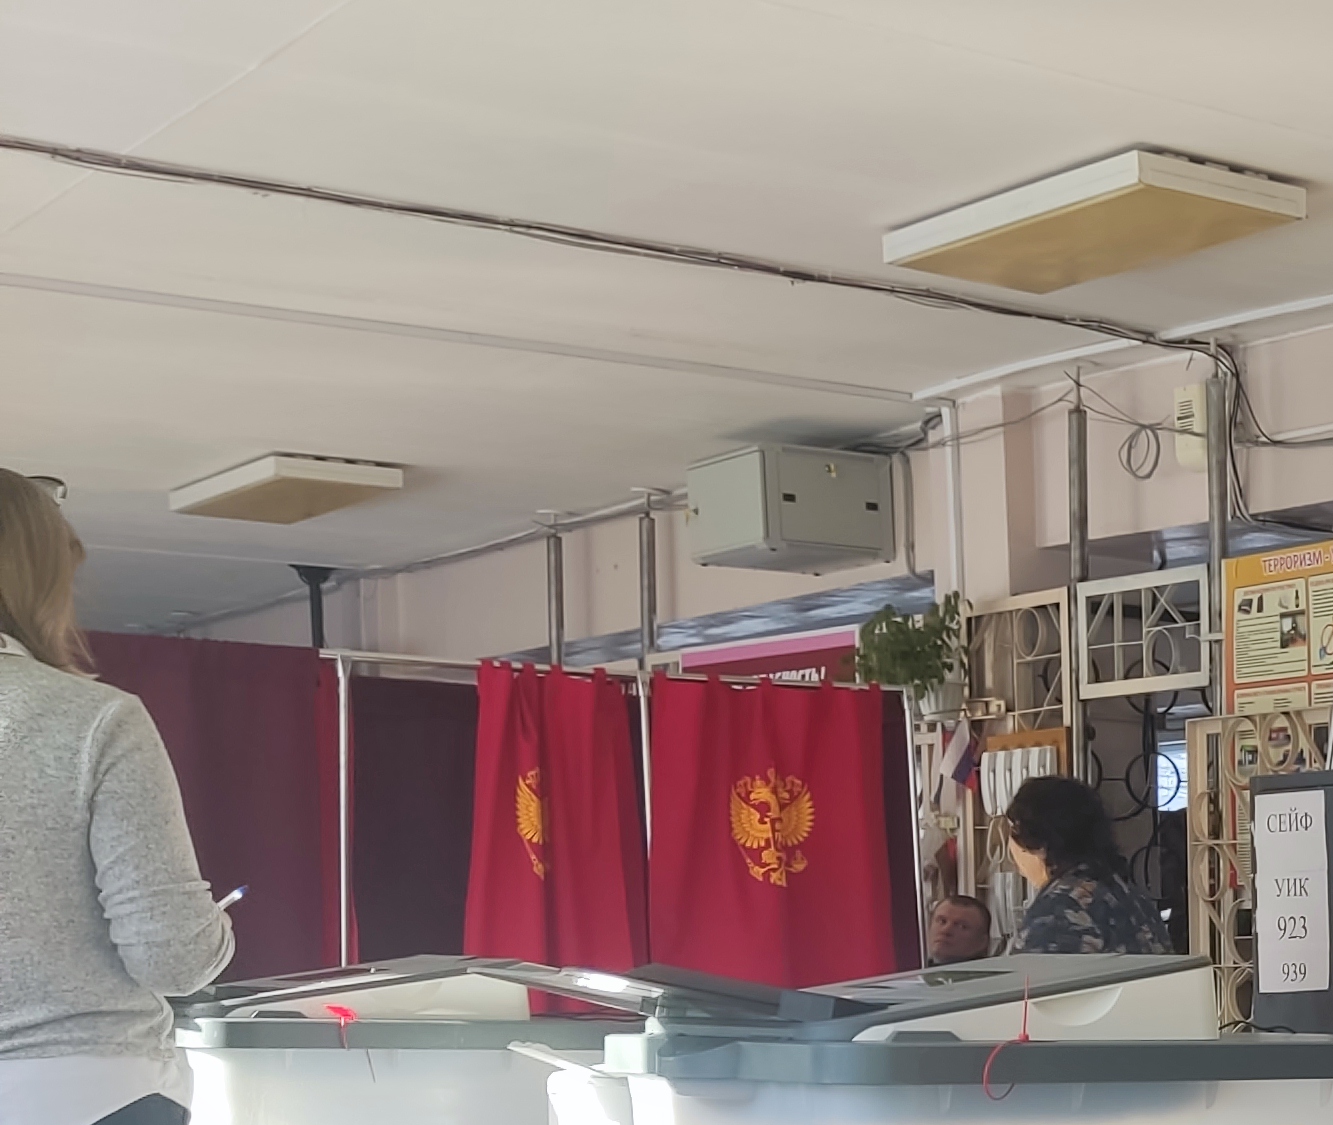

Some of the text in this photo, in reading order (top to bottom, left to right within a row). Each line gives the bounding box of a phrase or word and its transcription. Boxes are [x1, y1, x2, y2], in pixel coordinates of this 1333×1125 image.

[1262, 549, 1323, 574] ТЕРРОРИЗМ
[1266, 807, 1313, 834] СЕЙФ
[1274, 877, 1310, 898] УИК
[1277, 915, 1308, 941] 923
[1282, 962, 1307, 984] 939
